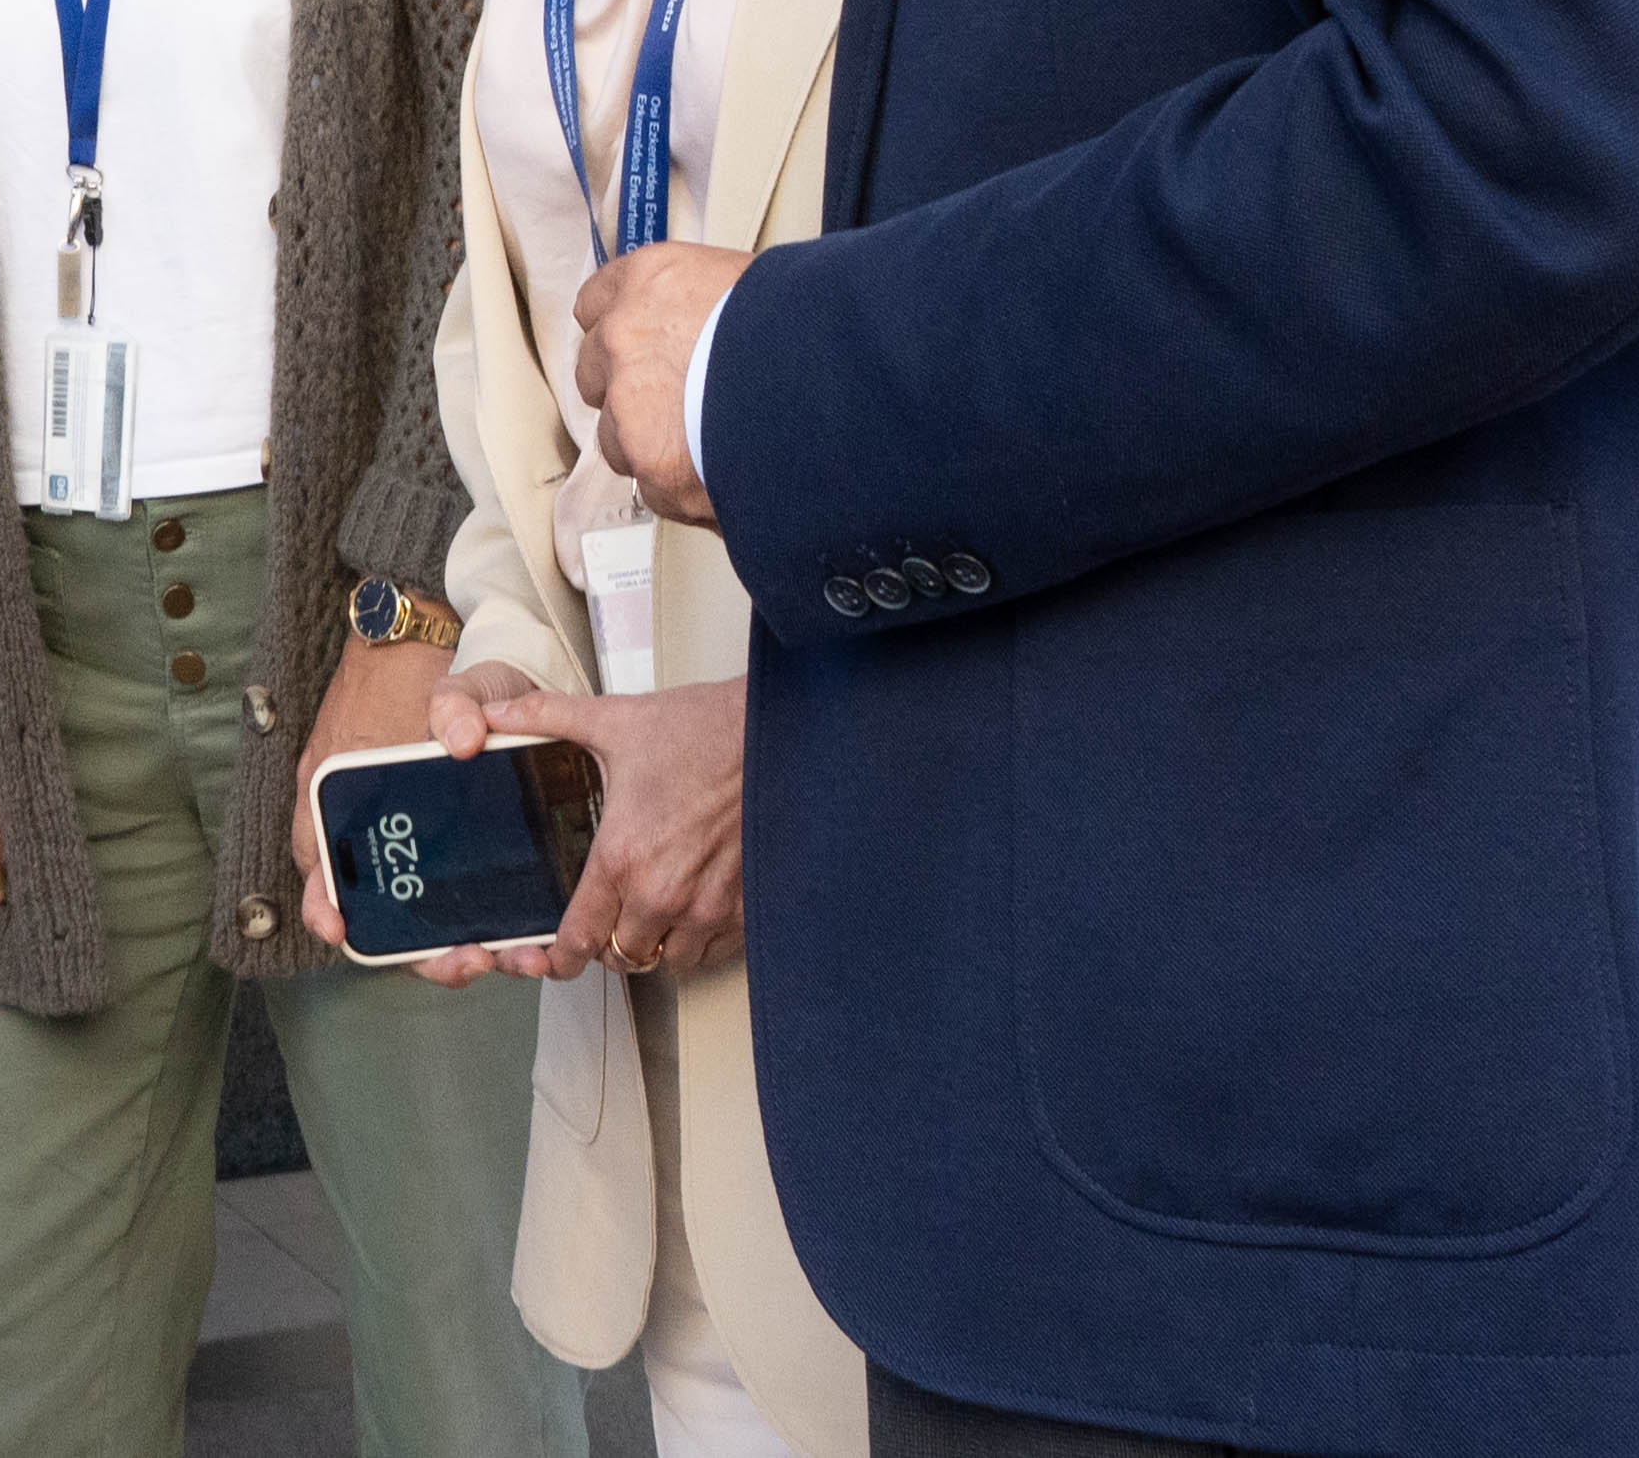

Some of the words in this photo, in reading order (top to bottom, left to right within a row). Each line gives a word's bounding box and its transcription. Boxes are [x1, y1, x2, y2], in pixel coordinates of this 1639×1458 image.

[650, 95, 661, 118] Osi
[645, 121, 660, 200] Ezkerraldea
[379, 812, 424, 901] 9:26
